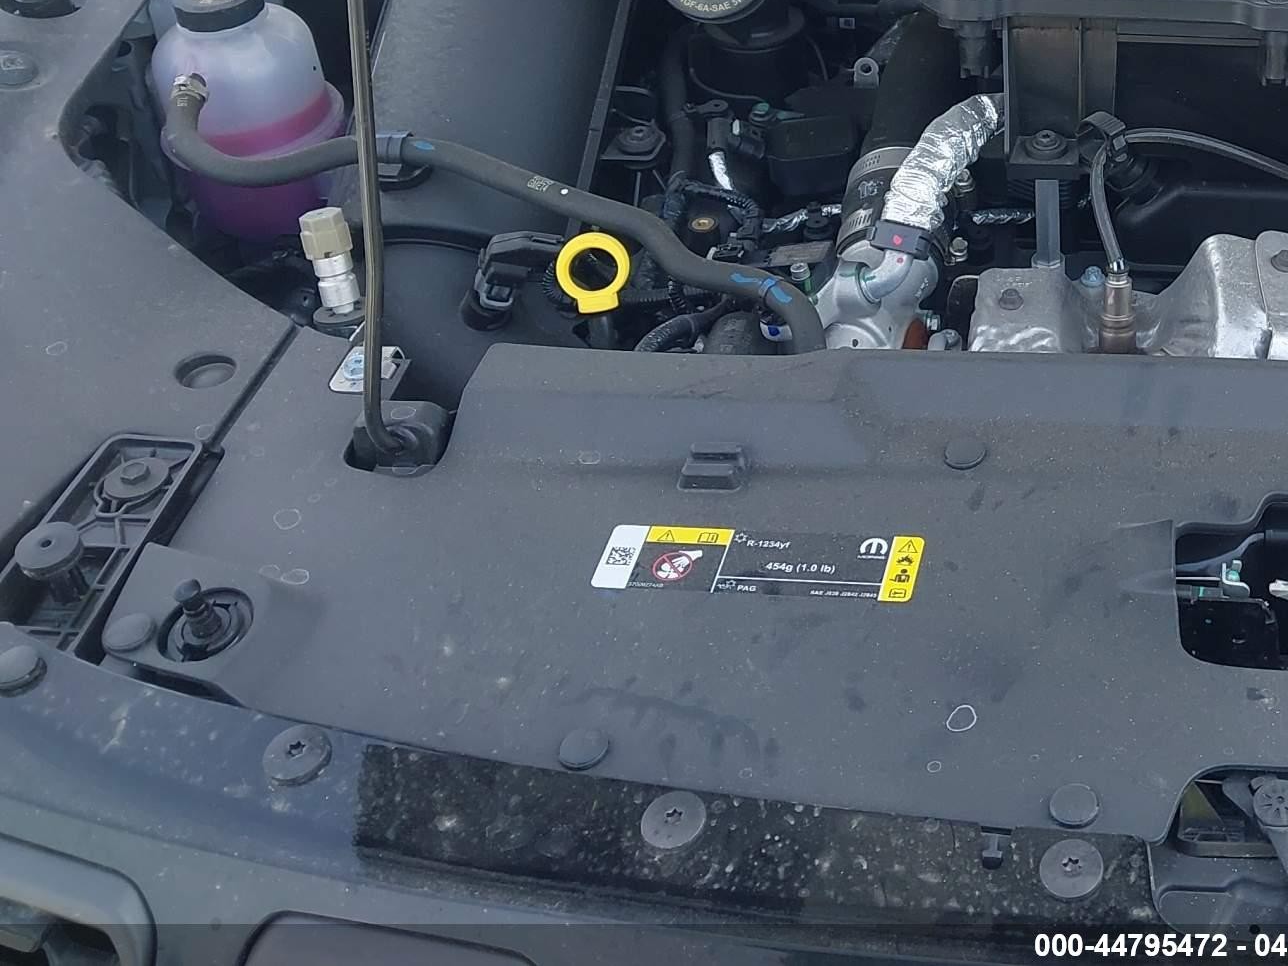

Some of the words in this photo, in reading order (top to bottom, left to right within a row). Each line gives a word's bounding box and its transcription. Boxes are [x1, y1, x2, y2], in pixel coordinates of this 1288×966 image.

[747, 540, 791, 550] R-1234yf
[765, 562, 794, 573] 454g
[796, 563, 817, 574] (1.0
[820, 564, 836, 575] lb)
[737, 584, 757, 592] PAG
